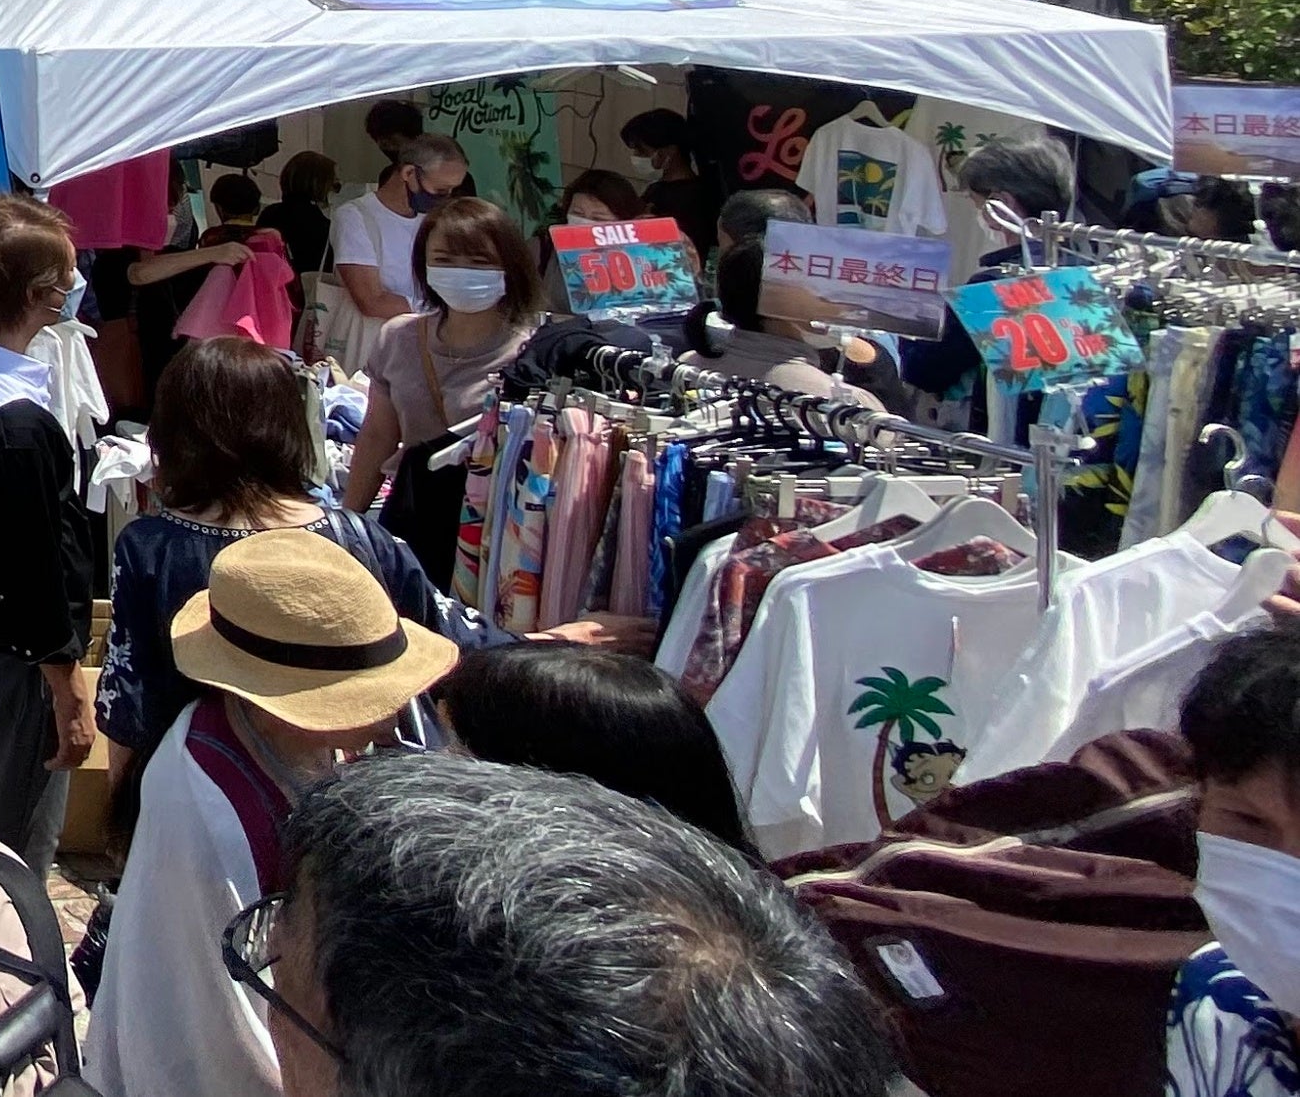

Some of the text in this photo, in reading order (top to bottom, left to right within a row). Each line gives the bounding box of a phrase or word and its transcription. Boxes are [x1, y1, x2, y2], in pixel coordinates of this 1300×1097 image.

[428, 78, 490, 120] Local
[452, 104, 516, 138] Motion
[592, 223, 640, 246] SALE
[578, 250, 637, 294] 50
[769, 249, 940, 294] 本日最終日
[992, 313, 1070, 372] 20
